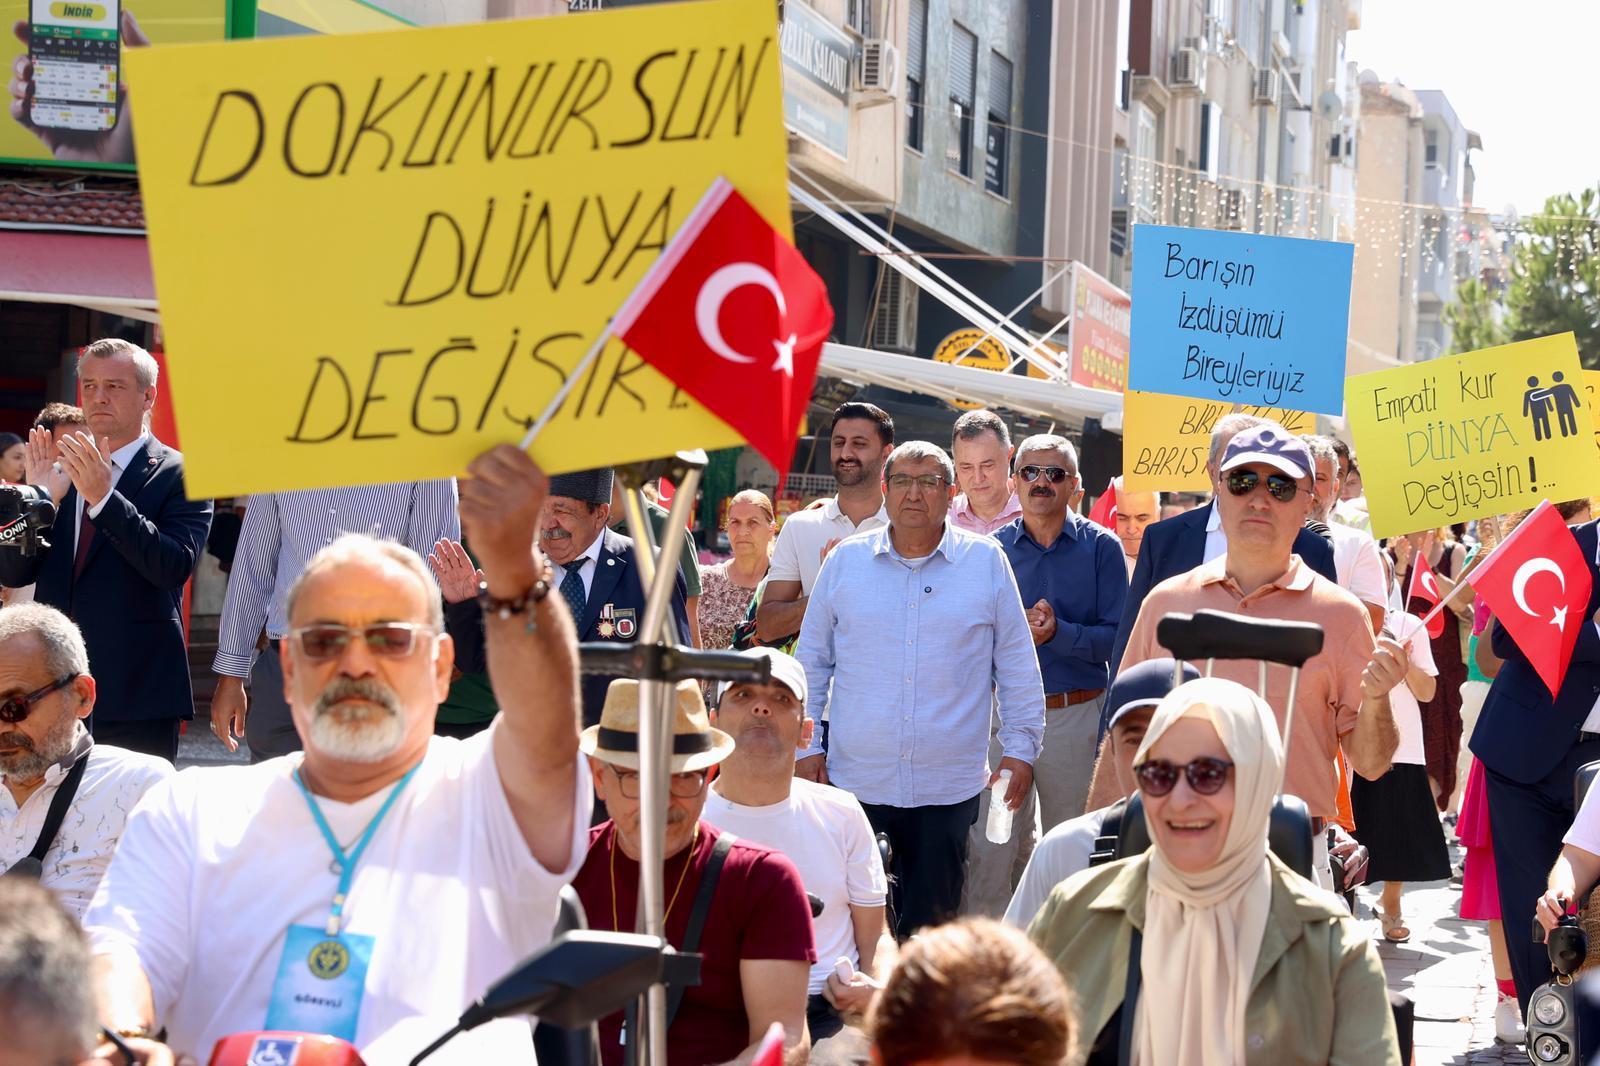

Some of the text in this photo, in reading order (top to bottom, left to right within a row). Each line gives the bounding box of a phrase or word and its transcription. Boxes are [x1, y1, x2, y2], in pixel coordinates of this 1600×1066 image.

[63, 4, 93, 18] İNDİR
[813, 40, 848, 94] SALONU
[189, 38, 772, 187] DOKUNURSUN
[385, 187, 675, 307] DÜNYA
[1164, 242, 1255, 289] Barışın
[1178, 291, 1285, 340] İzdüşümü
[286, 316, 688, 443] DEĞİŞİR
[1182, 345, 1305, 405] Bireyleriyiz
[1374, 376, 1436, 424] Empati
[1132, 446, 1209, 478] BARIŞ
[1407, 413, 1519, 467] DÜNYA
